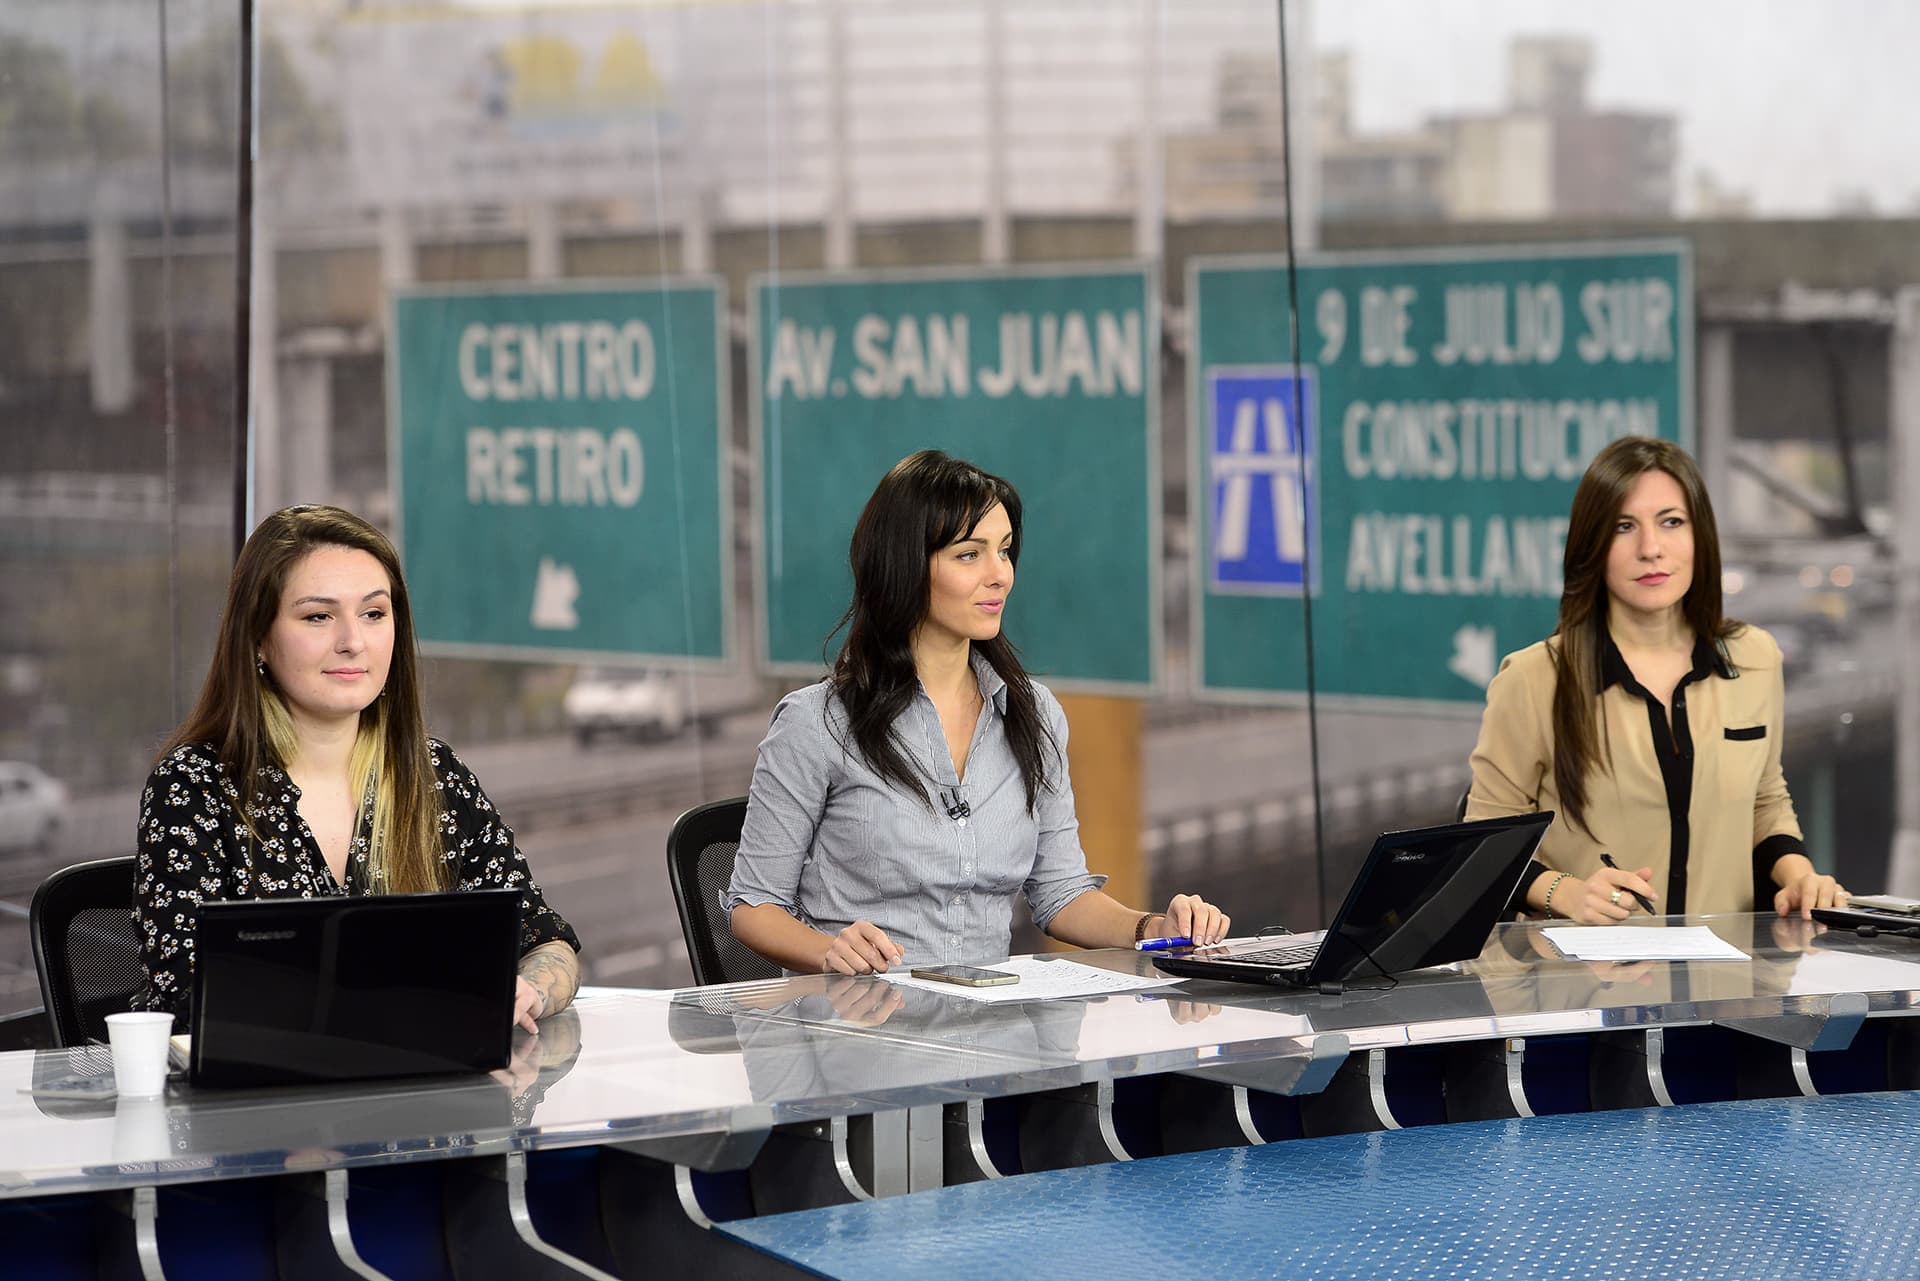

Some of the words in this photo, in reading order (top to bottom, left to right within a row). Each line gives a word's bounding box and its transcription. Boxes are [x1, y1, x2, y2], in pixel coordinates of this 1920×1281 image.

[459, 321, 655, 400] CENTRO
[852, 313, 969, 399] SAN
[978, 309, 1143, 397] JUAN
[1316, 288, 1347, 365] 9
[1360, 286, 1417, 366] DE
[1433, 281, 1564, 365] JULIO
[1577, 278, 1674, 363] SUR
[466, 427, 645, 507] RETIRO
[1345, 513, 1569, 597] AVELLANE
